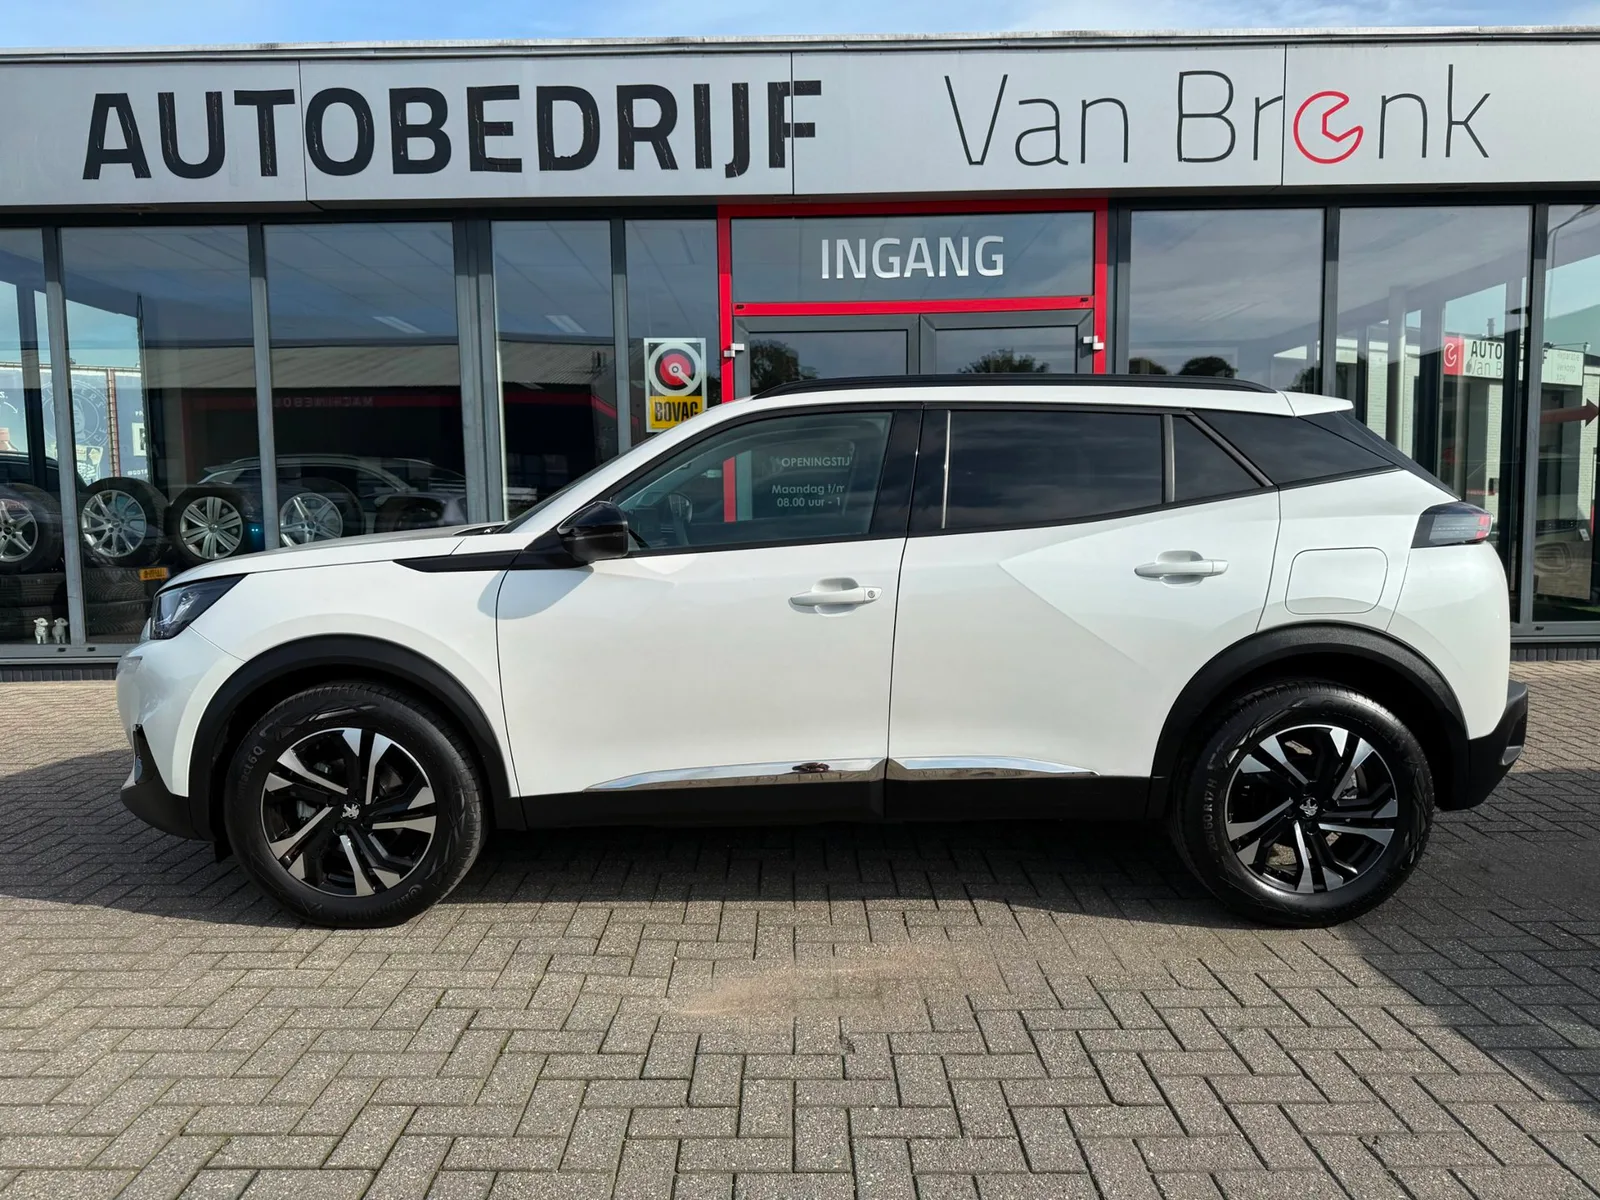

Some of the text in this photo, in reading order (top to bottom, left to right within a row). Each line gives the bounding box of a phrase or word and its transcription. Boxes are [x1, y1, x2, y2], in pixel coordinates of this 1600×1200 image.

[83, 80, 823, 180] AUTOBEDRIJF
[944, 73, 1129, 166] Van
[821, 235, 1005, 279] INGANG
[654, 401, 699, 422] BOVAG
[781, 456, 853, 468] OPENINGSTIJ
[771, 484, 825, 496] Maandag
[776, 497, 805, 508] 08.00
[808, 498, 826, 507] uur
